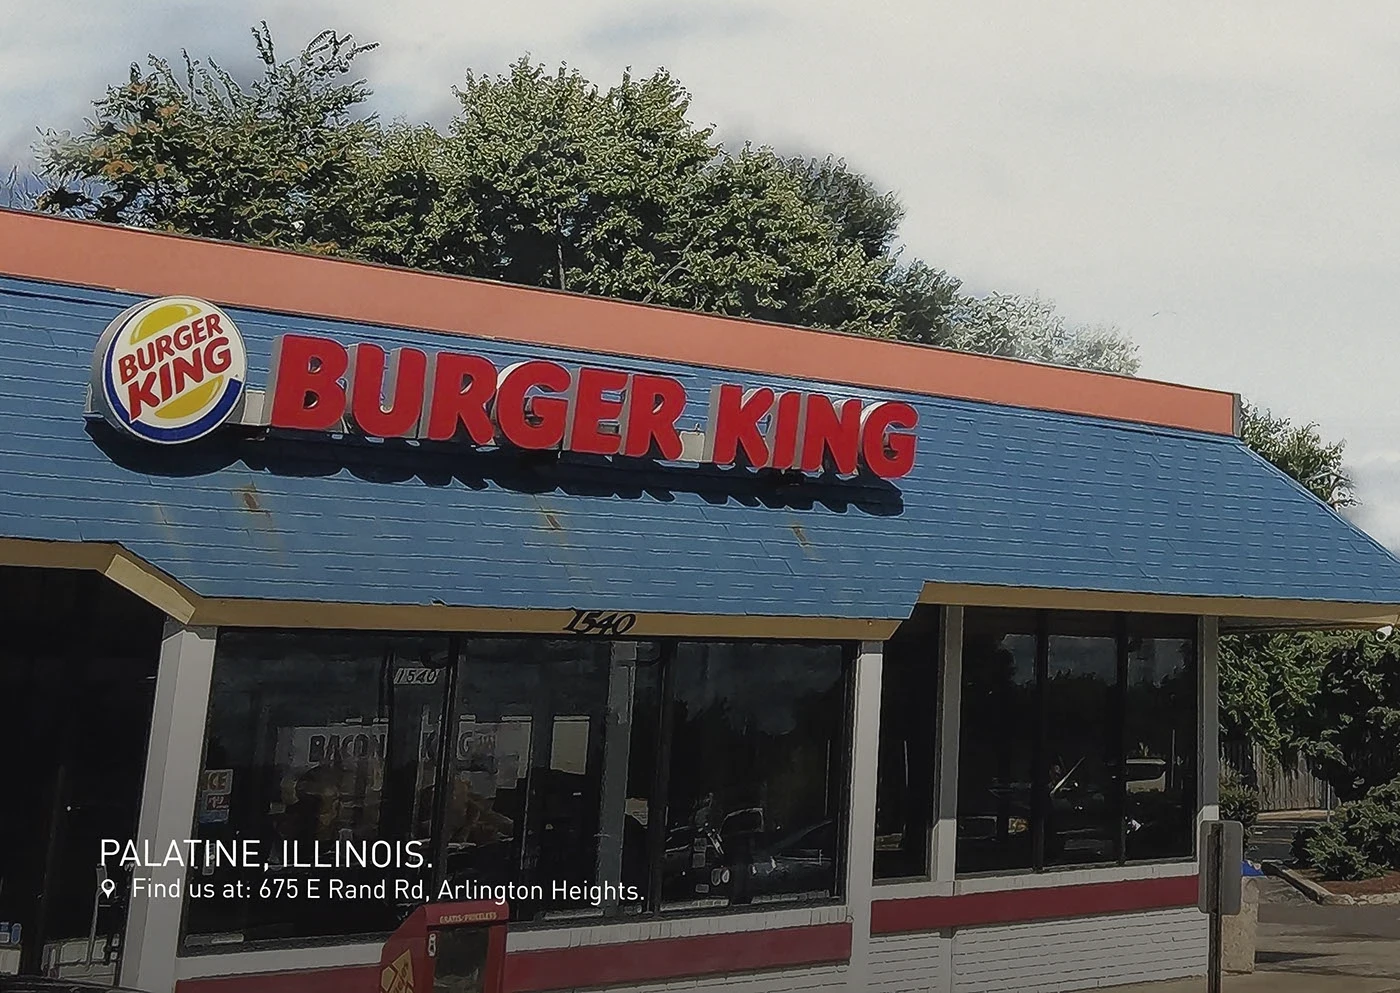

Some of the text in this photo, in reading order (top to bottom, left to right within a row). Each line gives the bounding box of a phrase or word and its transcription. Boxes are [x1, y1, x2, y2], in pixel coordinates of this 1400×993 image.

[118, 313, 224, 385] BURGER
[128, 336, 232, 422] KING
[270, 334, 920, 479] BURGER KING
[563, 609, 636, 635] 1540
[397, 668, 438, 684] 1540
[308, 732, 385, 762] BACON
